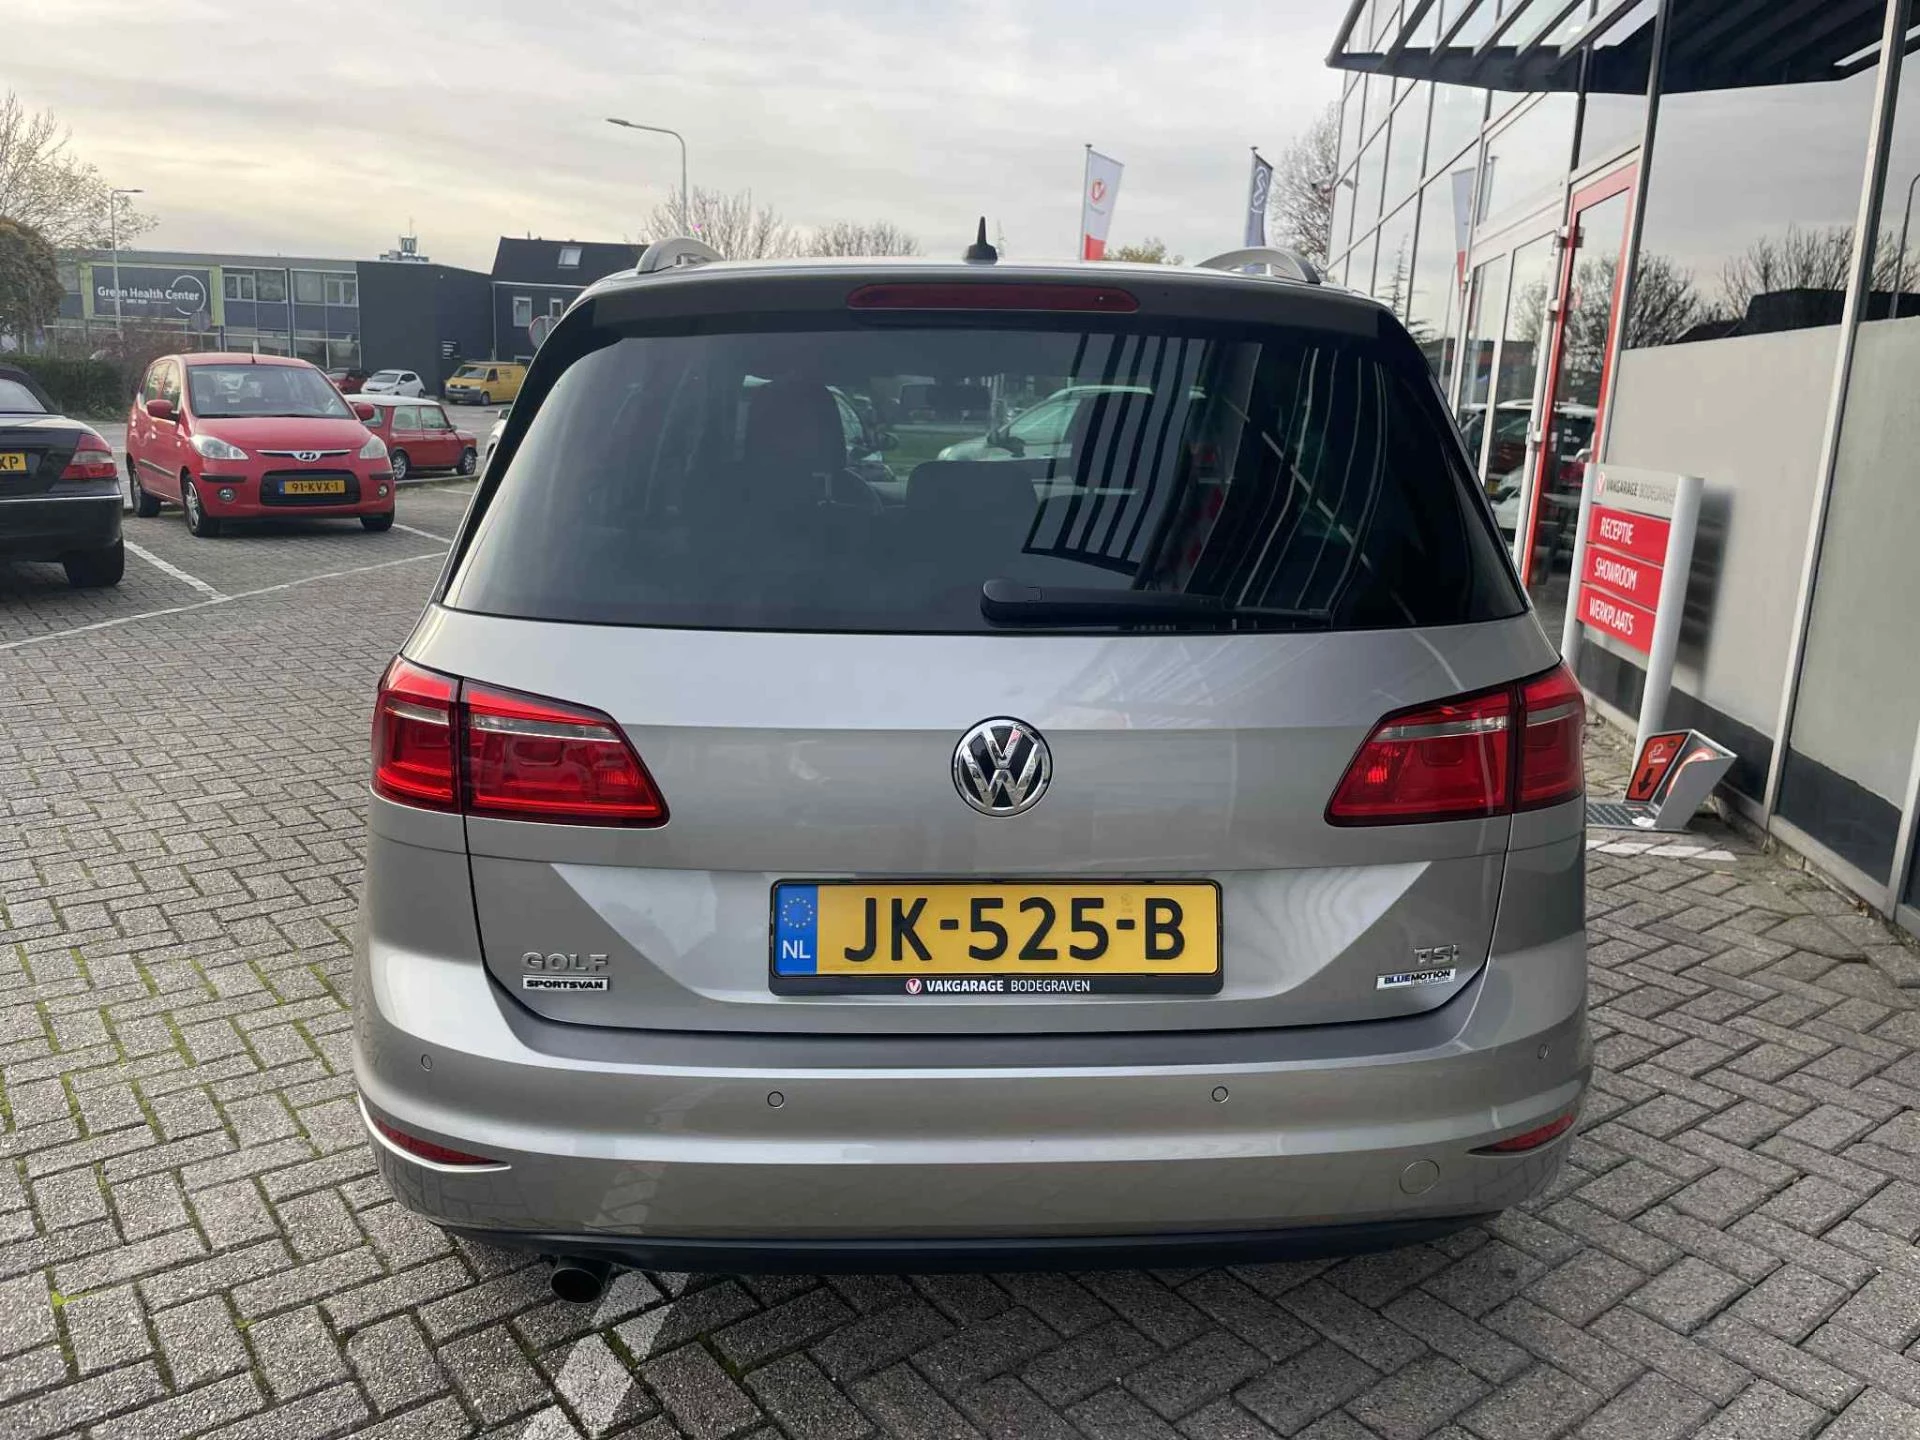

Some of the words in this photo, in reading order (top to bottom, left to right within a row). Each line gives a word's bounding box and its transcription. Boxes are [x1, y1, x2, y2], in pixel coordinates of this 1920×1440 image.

[129, 287, 163, 299] Health
[165, 289, 200, 301] Center
[292, 482, 339, 492] 91-KVX-1
[1600, 517, 1634, 545] RECEPTIE
[1594, 556, 1638, 591] SHOWROOM
[1589, 596, 1634, 636] WERKPLAATS
[844, 897, 1186, 962] JK-525-B
[782, 940, 811, 959] NL
[521, 951, 609, 972] GOLF
[526, 980, 604, 989] SPORTSVAN
[926, 979, 1004, 993] VAKGARAGE
[1010, 979, 1091, 993] BODEGRAVEN
[1384, 970, 1451, 984] BLUEMOTION
